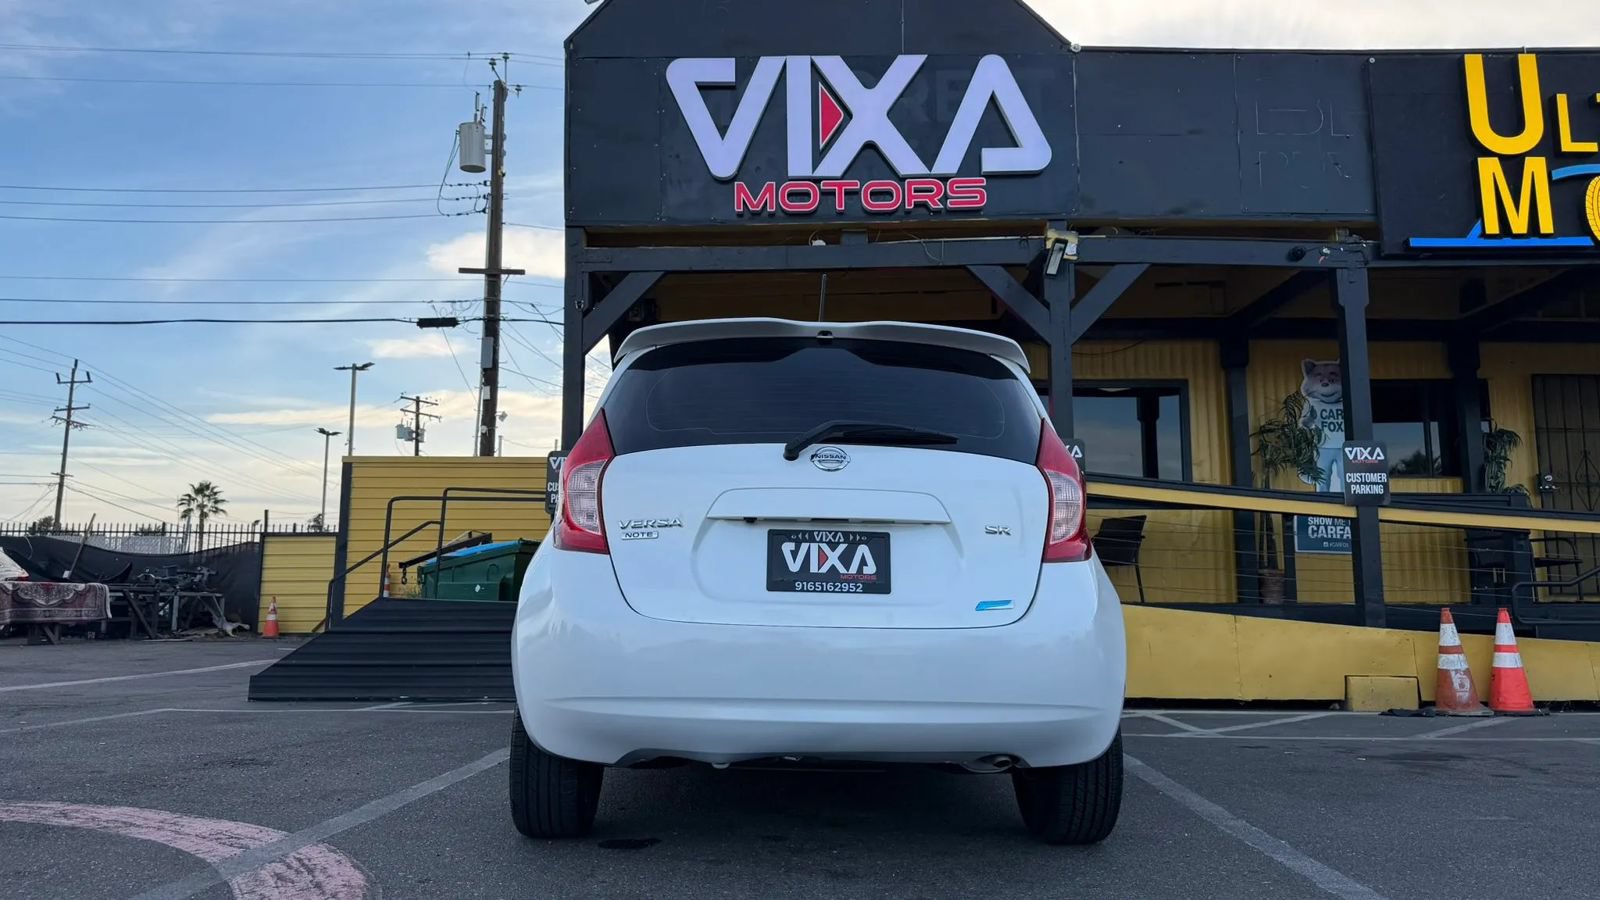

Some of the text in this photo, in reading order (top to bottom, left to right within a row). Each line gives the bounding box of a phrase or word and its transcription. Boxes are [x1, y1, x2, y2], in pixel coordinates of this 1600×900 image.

[1464, 53, 1600, 155] UL
[666, 54, 1053, 180] VIXA
[735, 177, 988, 214] MOTORS
[1320, 408, 1344, 420] CAR
[1321, 421, 1344, 432] FOX
[1345, 447, 1384, 460] VIXA
[1346, 473, 1387, 482] CUSTOMER
[1351, 485, 1384, 494] PARKING
[619, 519, 682, 529] VERSA
[1308, 517, 1332, 525] SHOW
[984, 525, 1012, 536] SR
[1308, 526, 1351, 539] CARFA
[814, 532, 845, 542] VIXA
[782, 542, 877, 574] VIXA
[795, 582, 863, 592] 9165162952
